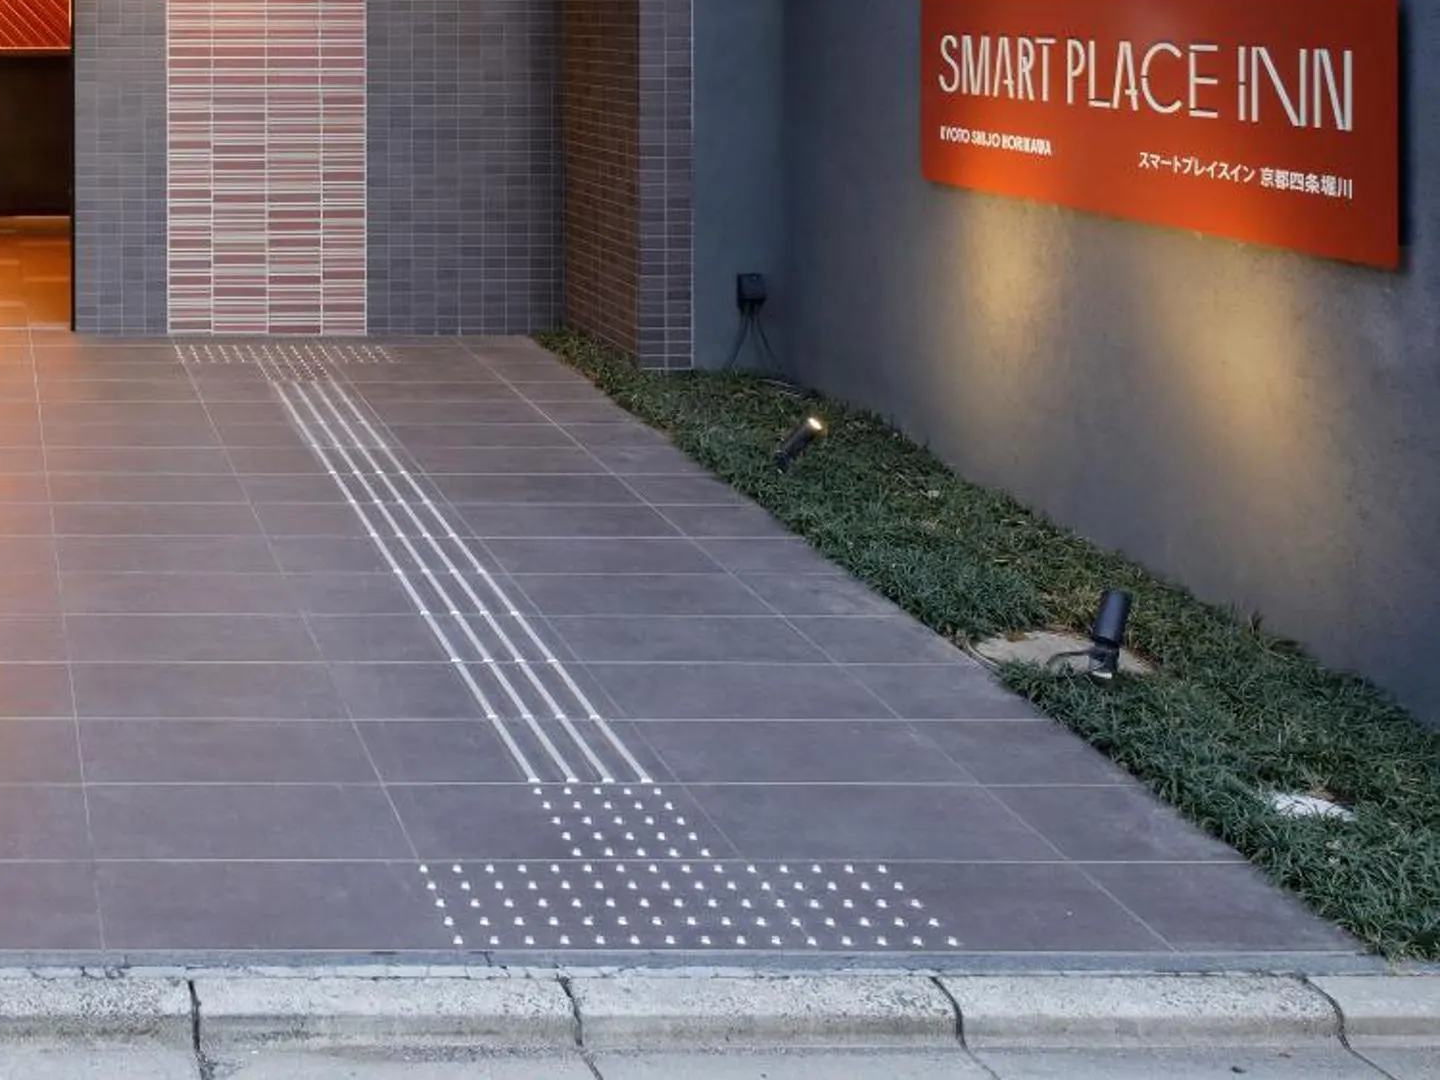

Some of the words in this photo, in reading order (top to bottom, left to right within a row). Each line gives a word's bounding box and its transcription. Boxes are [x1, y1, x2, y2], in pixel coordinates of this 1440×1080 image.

[938, 34, 1057, 103] SMART
[1066, 38, 1218, 119] PLACE
[1237, 45, 1353, 132] INN
